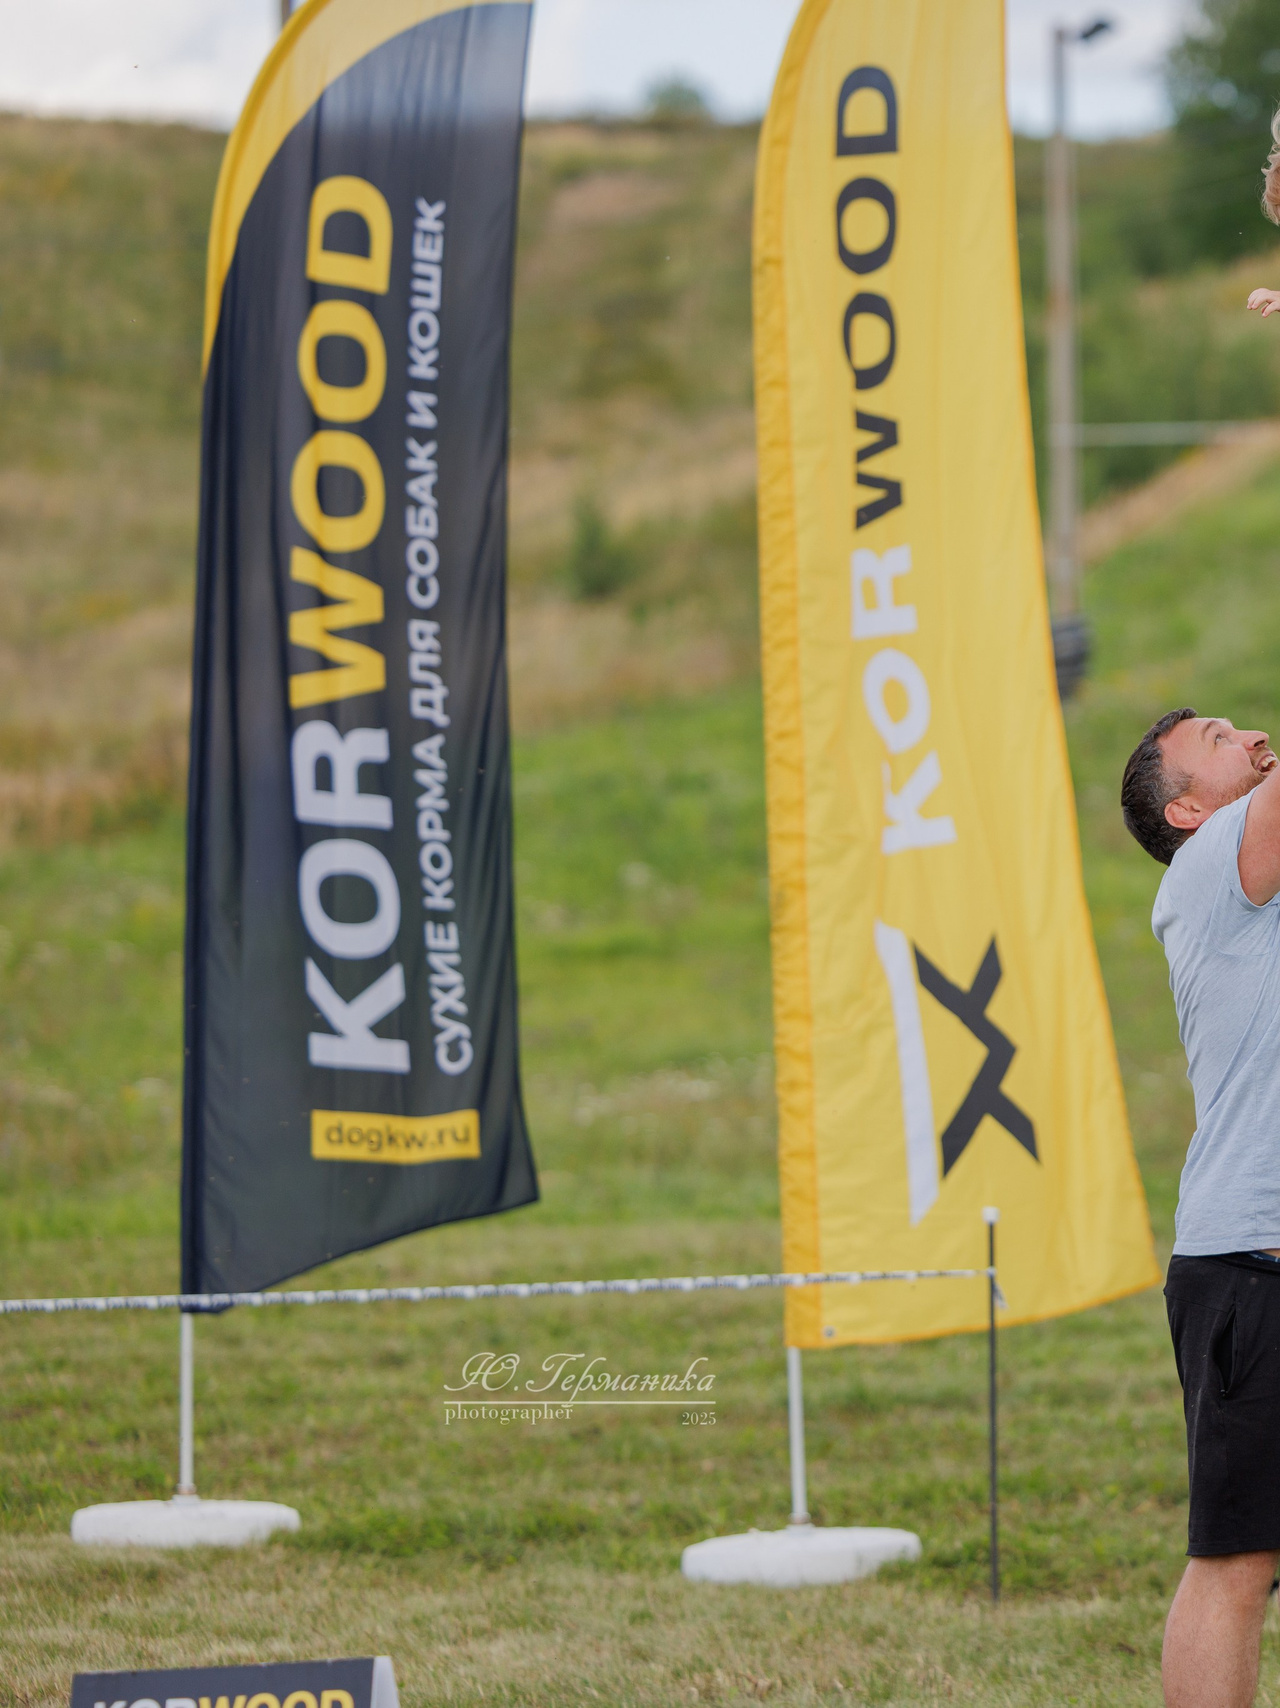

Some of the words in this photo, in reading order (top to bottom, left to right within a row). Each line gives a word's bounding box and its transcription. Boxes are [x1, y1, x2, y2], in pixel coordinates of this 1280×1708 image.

[408, 196, 446, 381] КОШЕК
[406, 390, 438, 428] И
[835, 65, 958, 856] KORWOOD
[405, 438, 440, 609] СОБАК
[289, 174, 411, 1075] KORWOOD
[409, 619, 450, 727] ДЛЯ
[412, 733, 456, 911] КОРМА
[423, 921, 474, 1076] СУХИЕ
[326, 1119, 470, 1152] dogkw.ru
